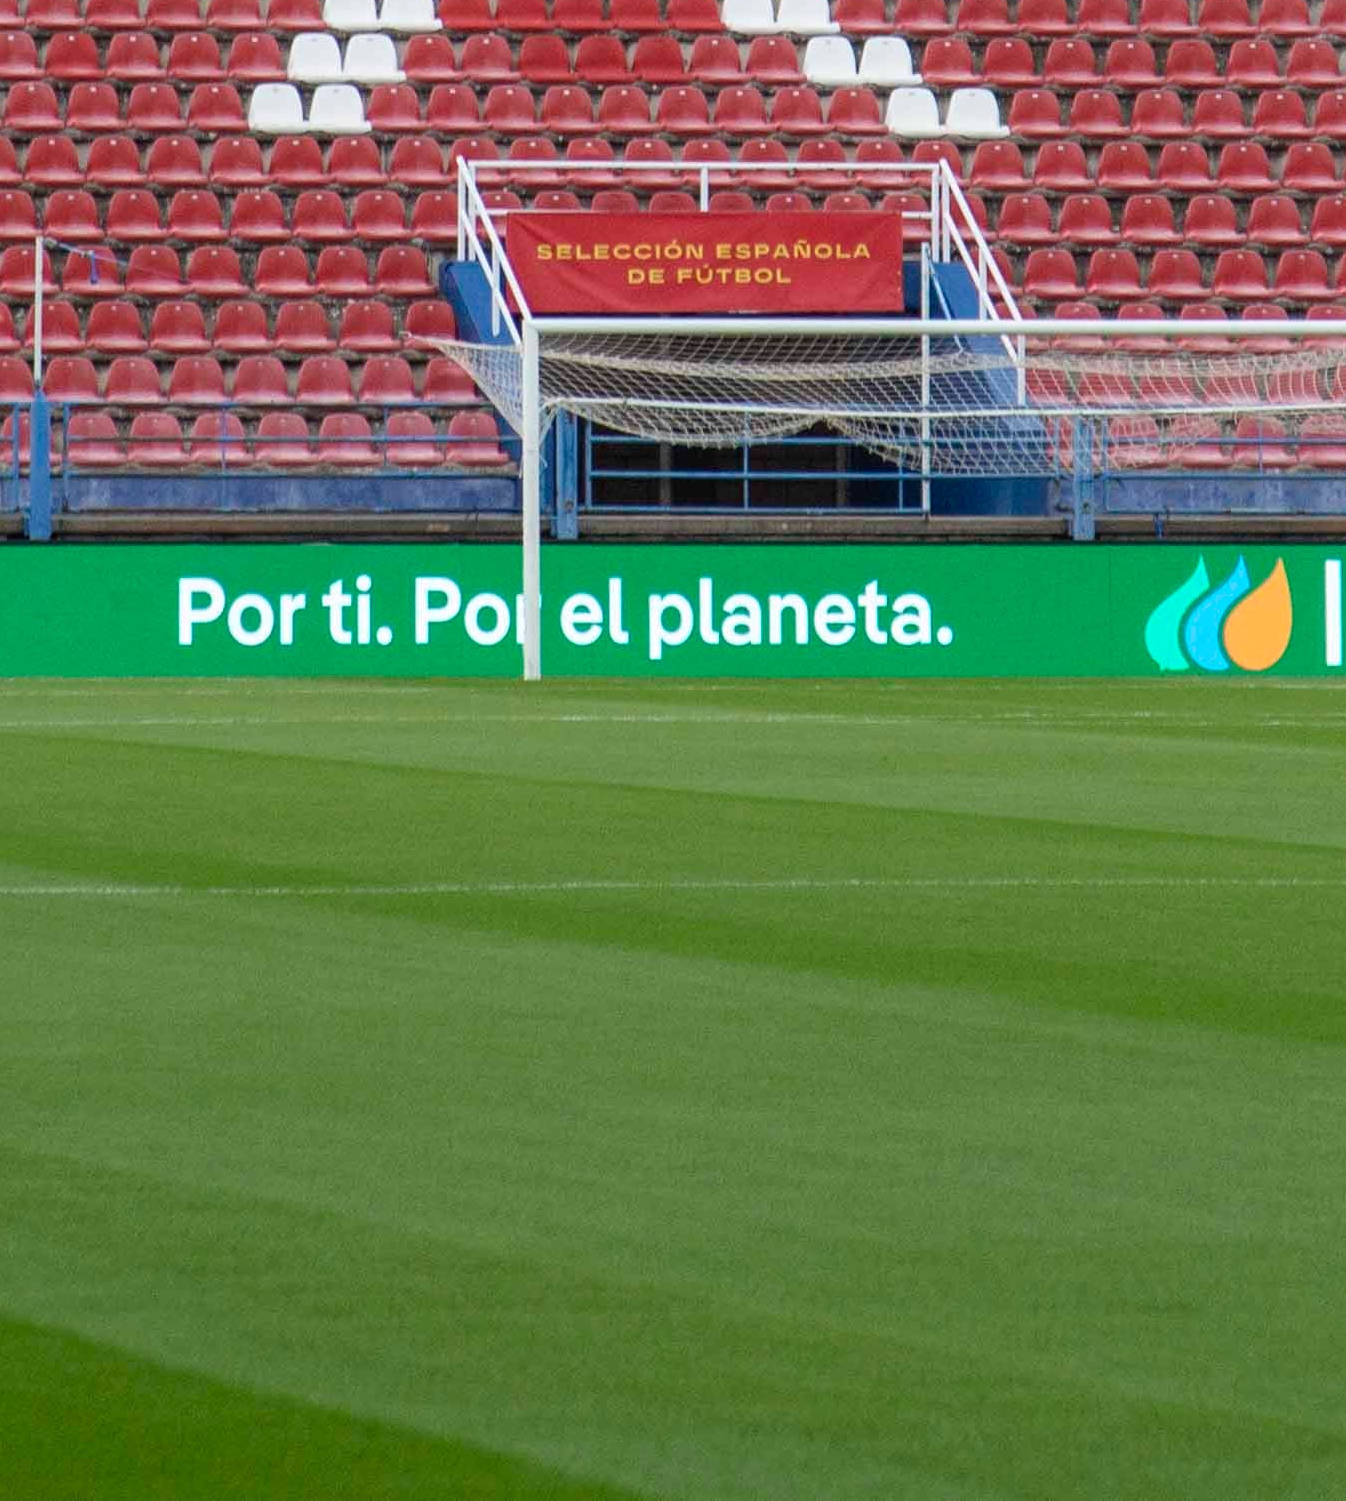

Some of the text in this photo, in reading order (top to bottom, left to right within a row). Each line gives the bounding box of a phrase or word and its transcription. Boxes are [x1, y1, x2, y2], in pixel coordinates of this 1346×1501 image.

[537, 239, 870, 259] SELECCIÓN ESPAÑOLA
[628, 264, 791, 284] DE FÚTBOL
[178, 577, 306, 646] Por
[321, 574, 393, 645] ti.
[560, 577, 629, 645] el
[648, 577, 953, 660] planeta.
